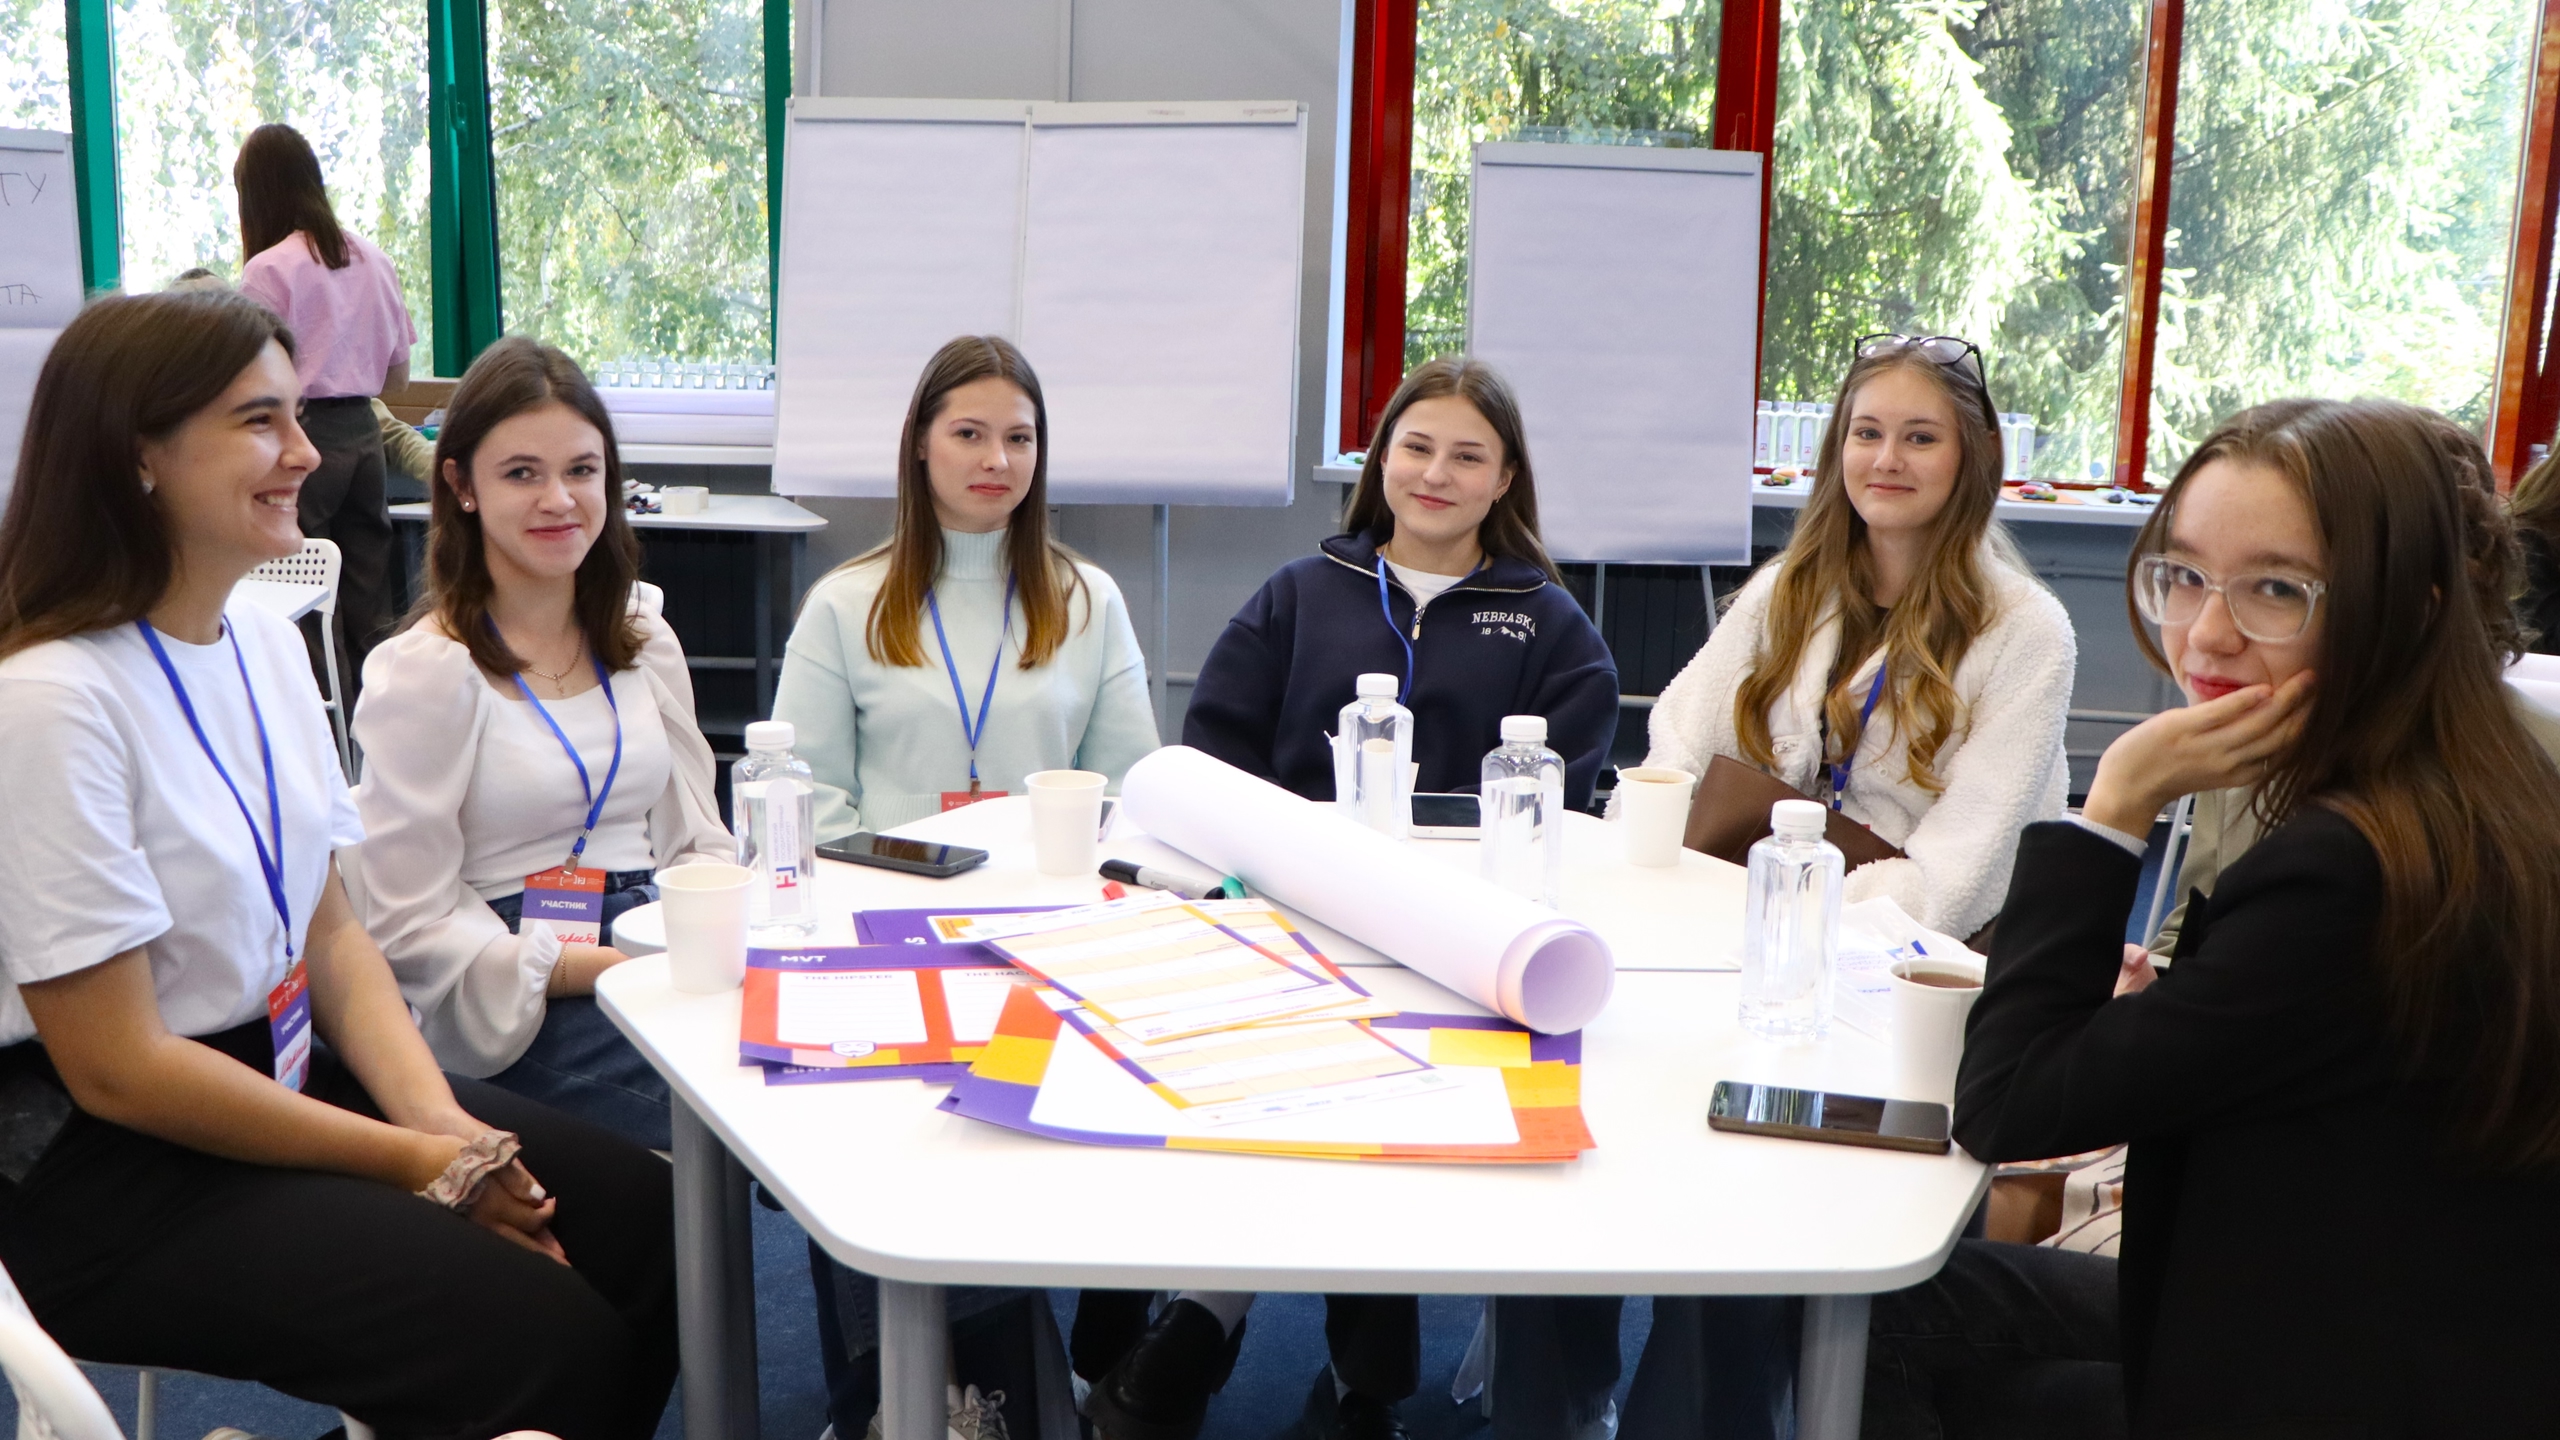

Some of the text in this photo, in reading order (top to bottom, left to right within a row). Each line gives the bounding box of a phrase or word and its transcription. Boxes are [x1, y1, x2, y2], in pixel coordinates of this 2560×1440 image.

[1471, 611, 1536, 637] NEBRASKA
[540, 900, 588, 910] УЧАСТНИК
[780, 955, 827, 963] MVT
